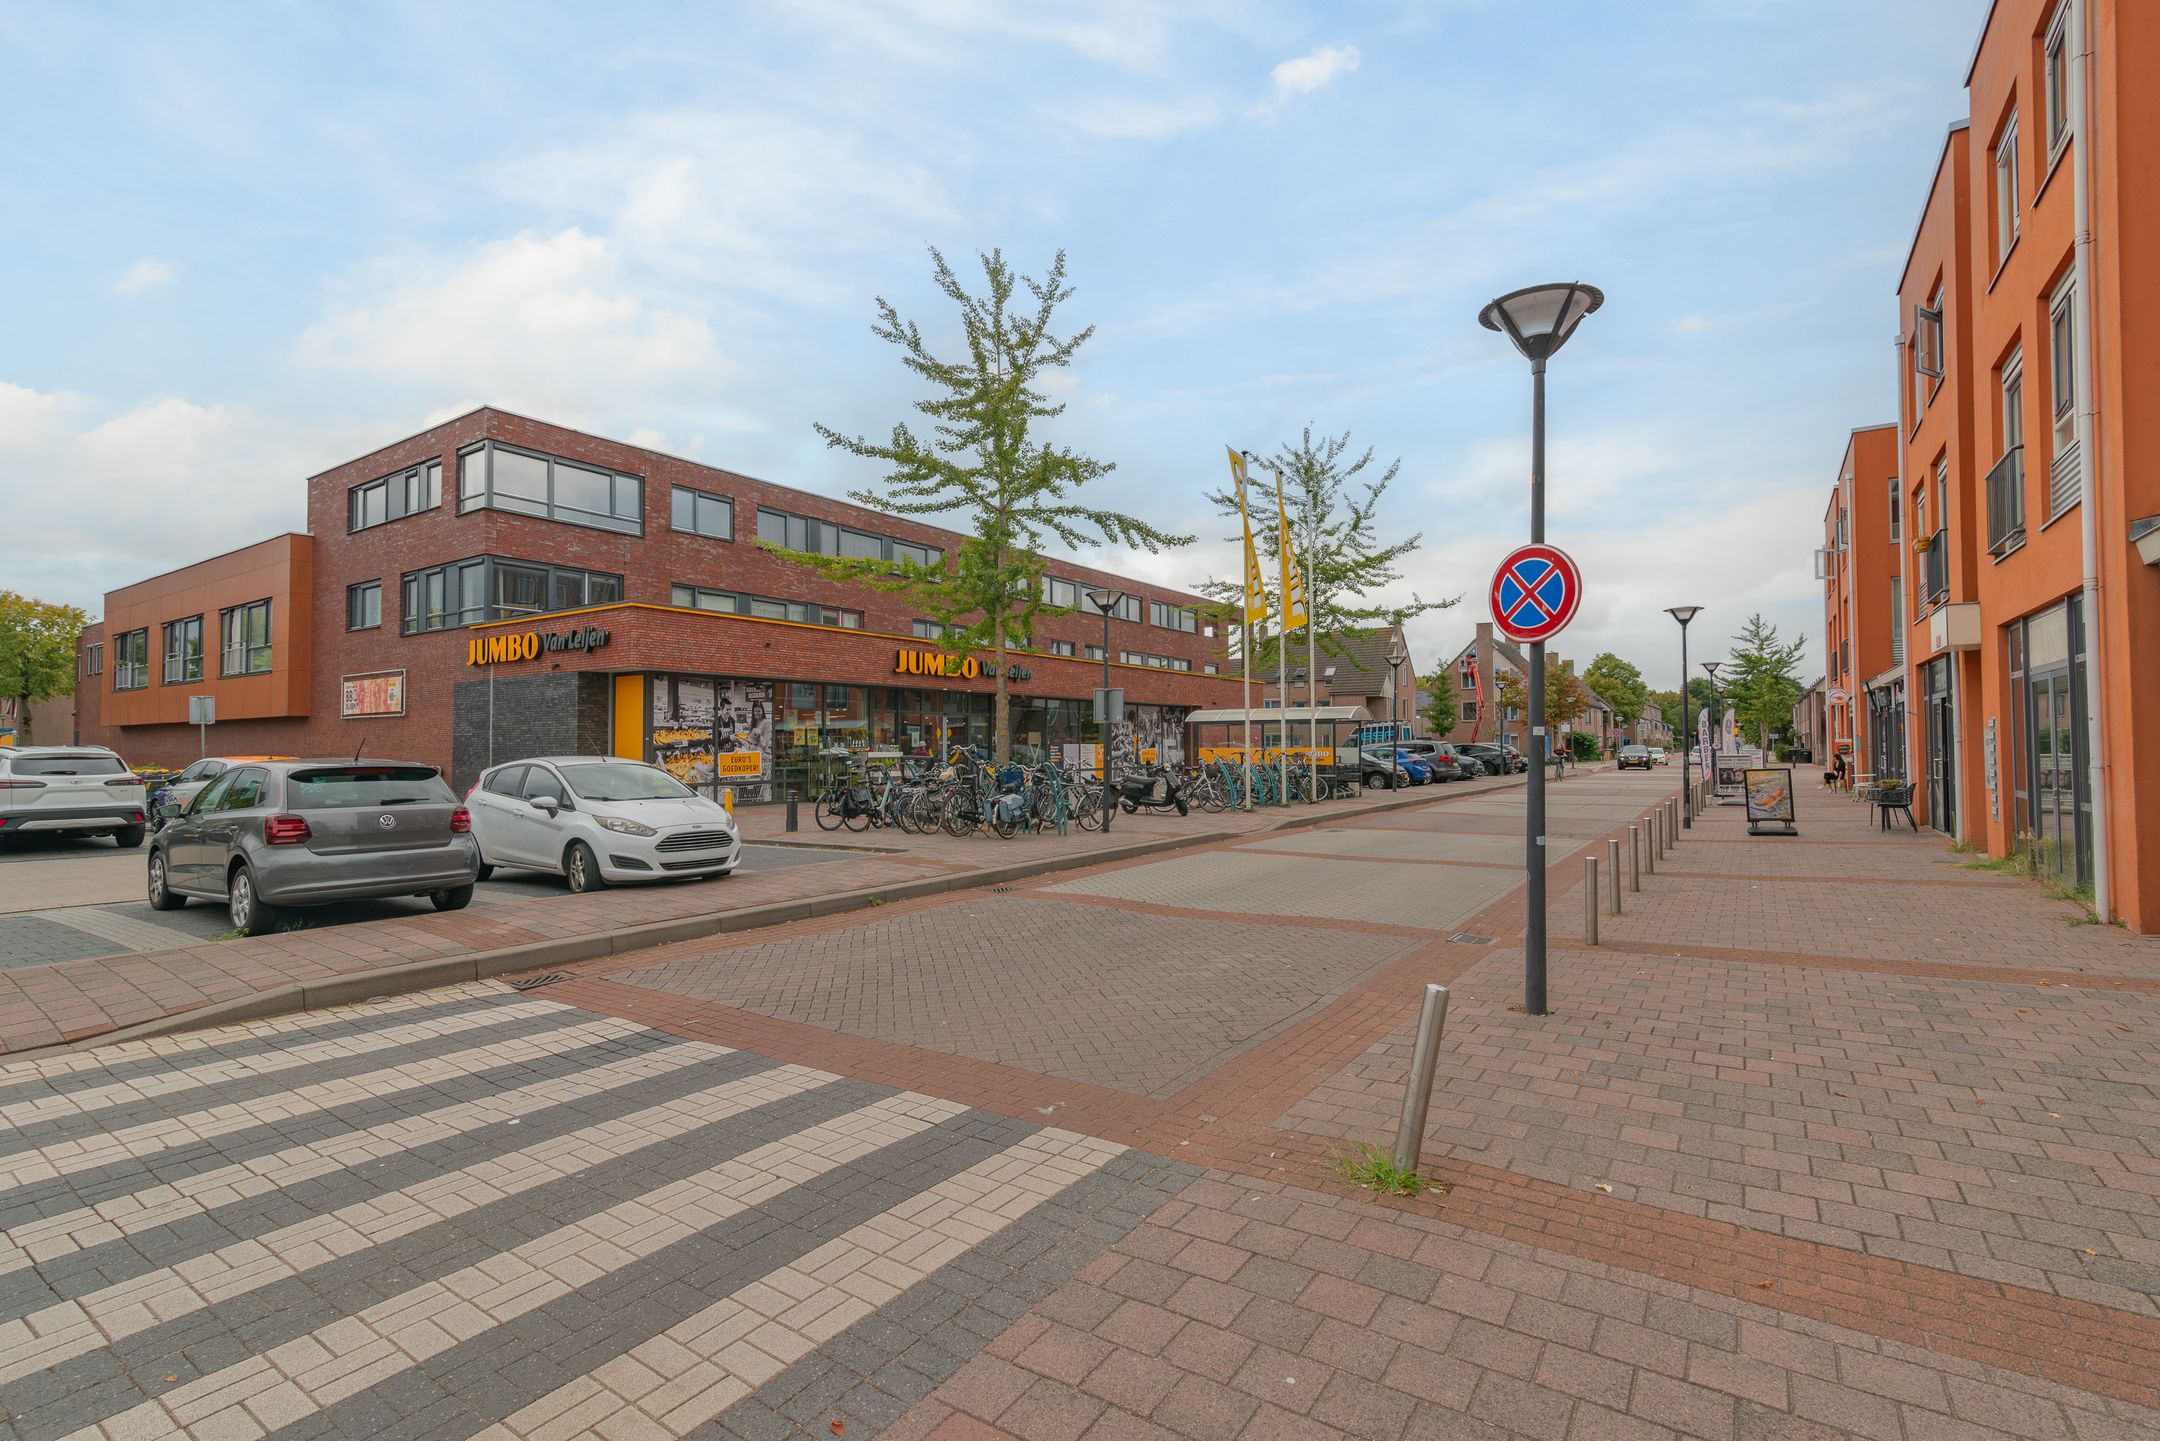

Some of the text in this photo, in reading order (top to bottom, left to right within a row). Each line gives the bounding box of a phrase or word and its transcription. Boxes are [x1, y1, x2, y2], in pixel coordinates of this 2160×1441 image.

[467, 626, 607, 666] JUMBO Van Leijen
[1702, 721, 1710, 770] BARBER
